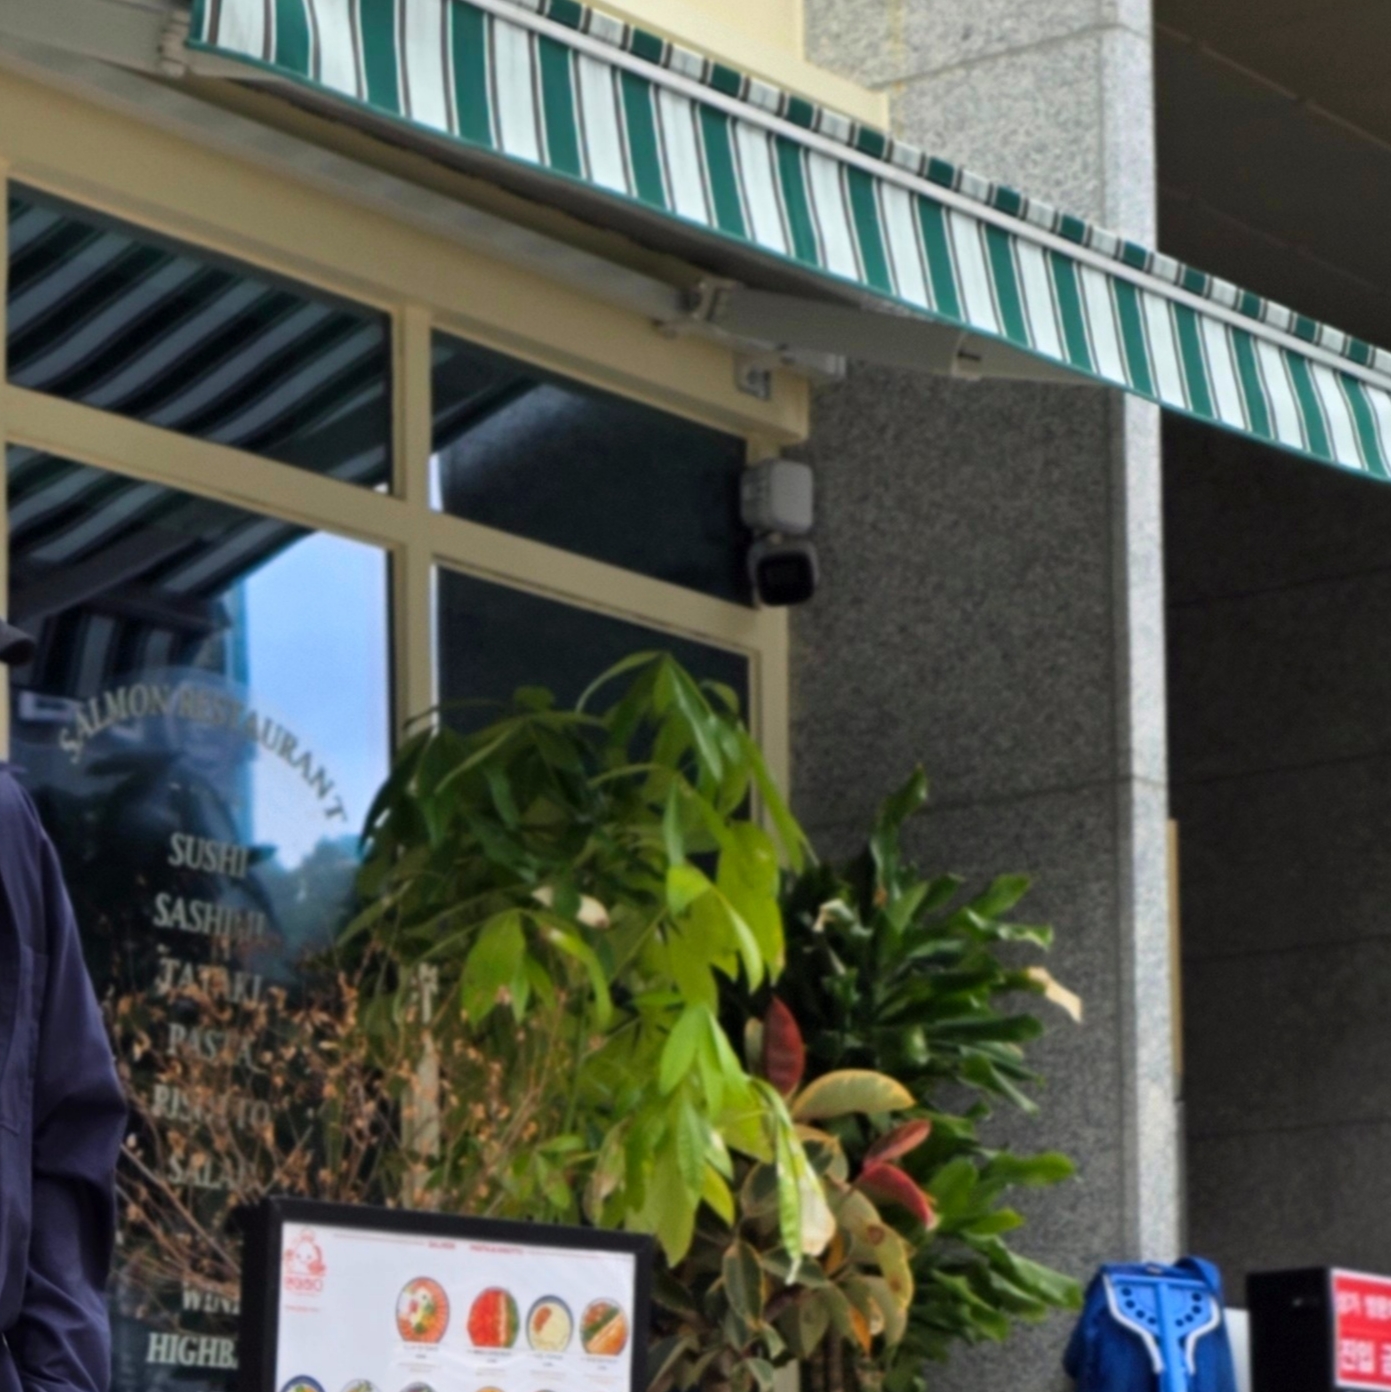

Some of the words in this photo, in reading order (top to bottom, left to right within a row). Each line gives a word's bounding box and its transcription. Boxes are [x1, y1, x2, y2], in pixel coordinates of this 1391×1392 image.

[60, 683, 170, 764] SALMON
[179, 686, 349, 823] RESTAURANT
[168, 832, 249, 879] SUSHI
[158, 957, 262, 1004] TATKI
[146, 1332, 239, 1369] HIGHB
